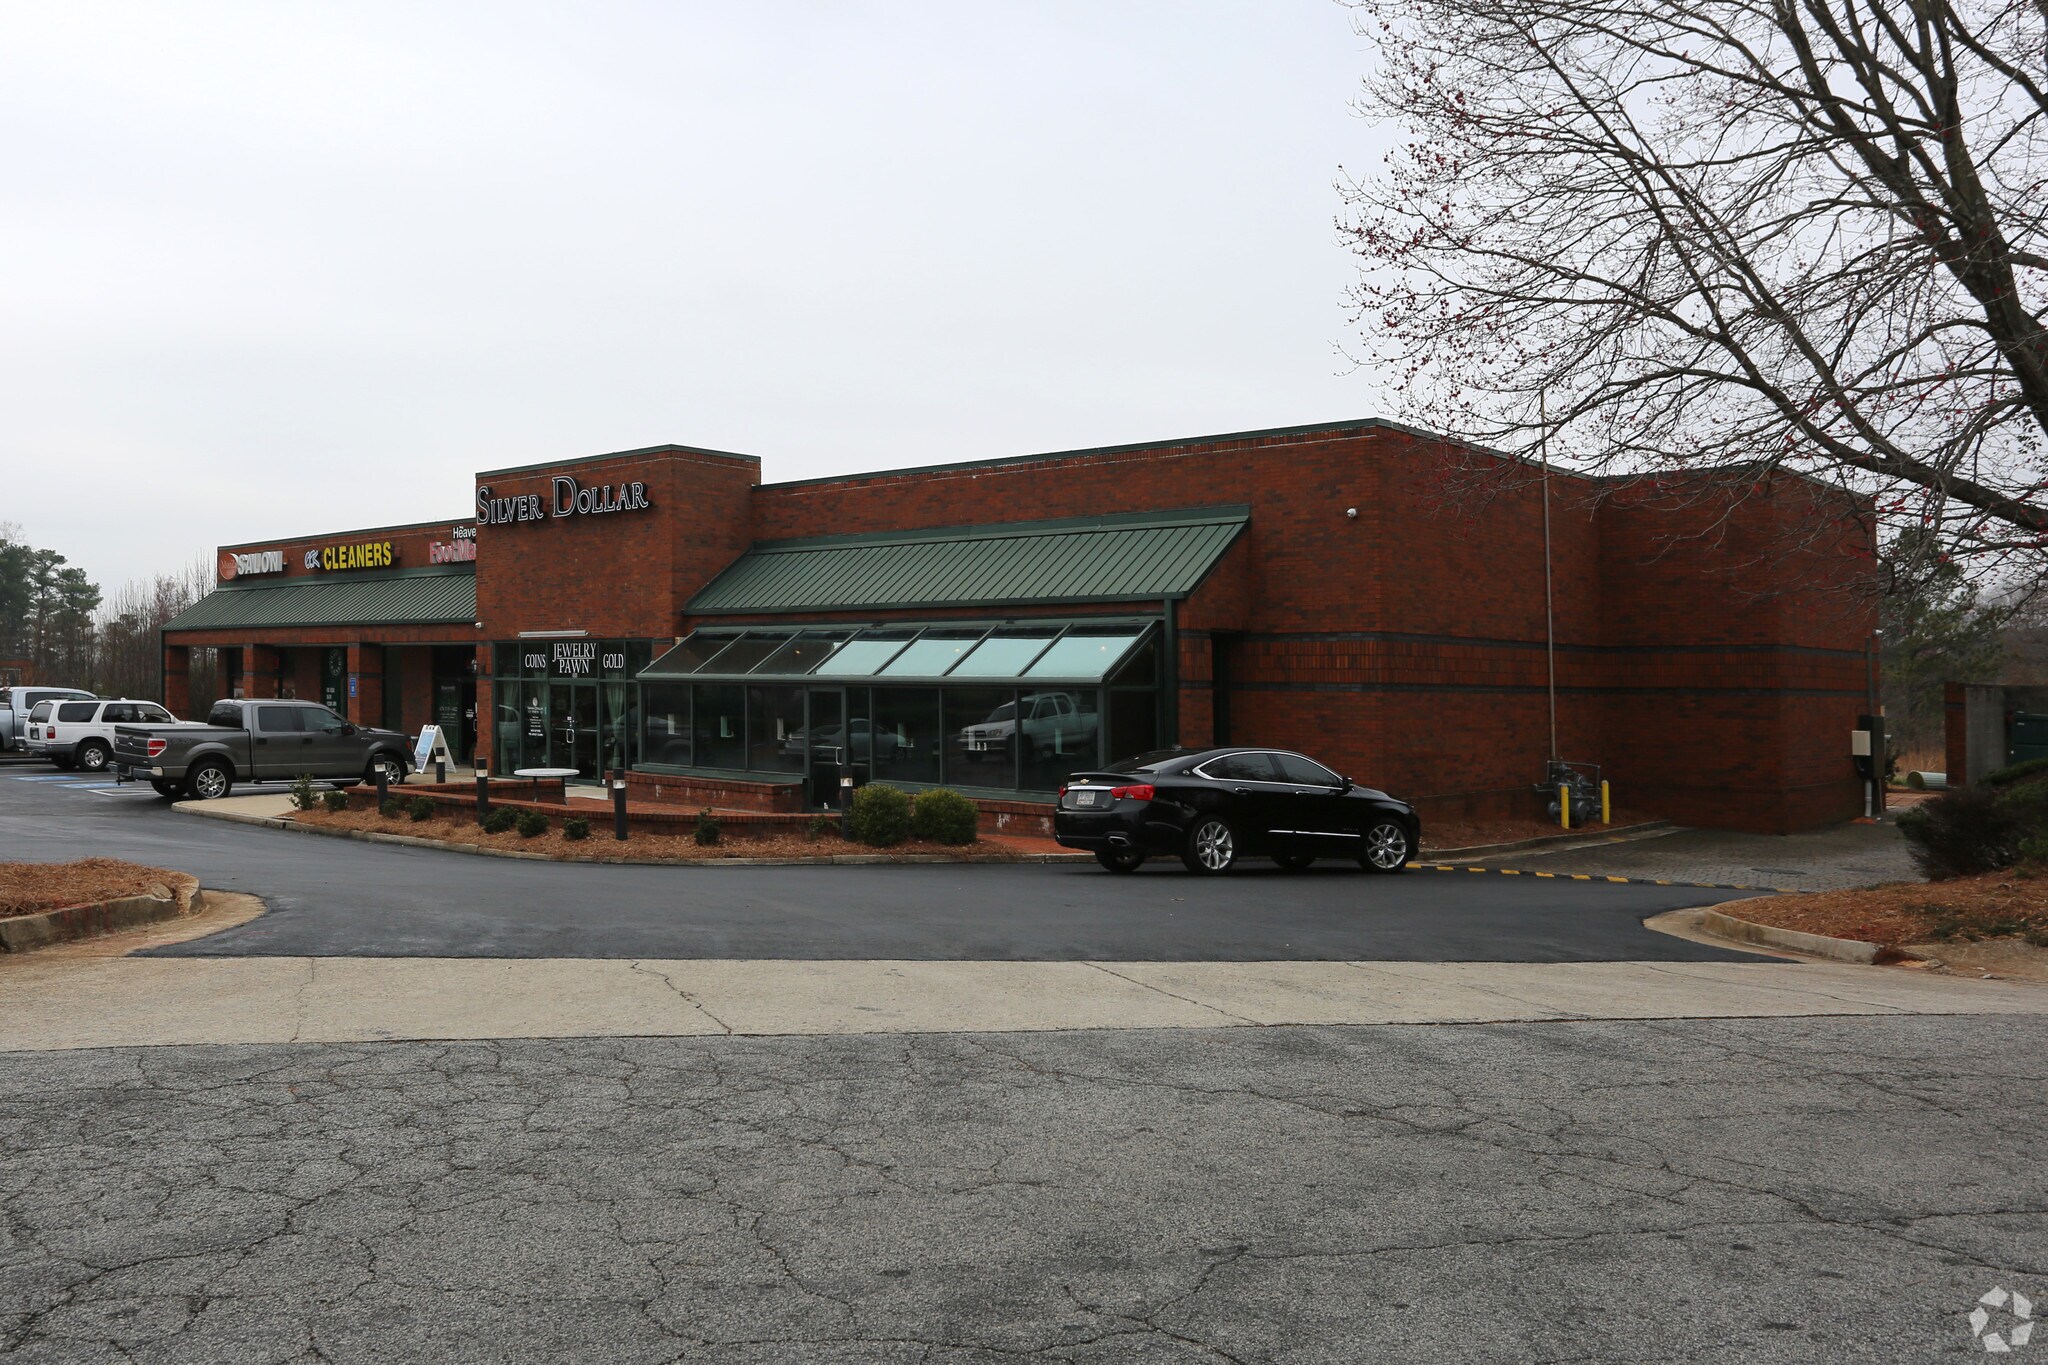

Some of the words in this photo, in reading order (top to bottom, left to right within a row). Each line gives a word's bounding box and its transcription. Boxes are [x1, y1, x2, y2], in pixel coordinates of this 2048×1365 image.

[476, 485, 544, 525] SILVER
[552, 475, 649, 518] DOLLAR
[237, 550, 283, 575] SALON
[323, 541, 392, 571] CLEANERS
[524, 653, 547, 668] COINS
[552, 642, 597, 662] JEWELRY
[603, 653, 624, 669] GOLD
[558, 659, 590, 674] PAWN
